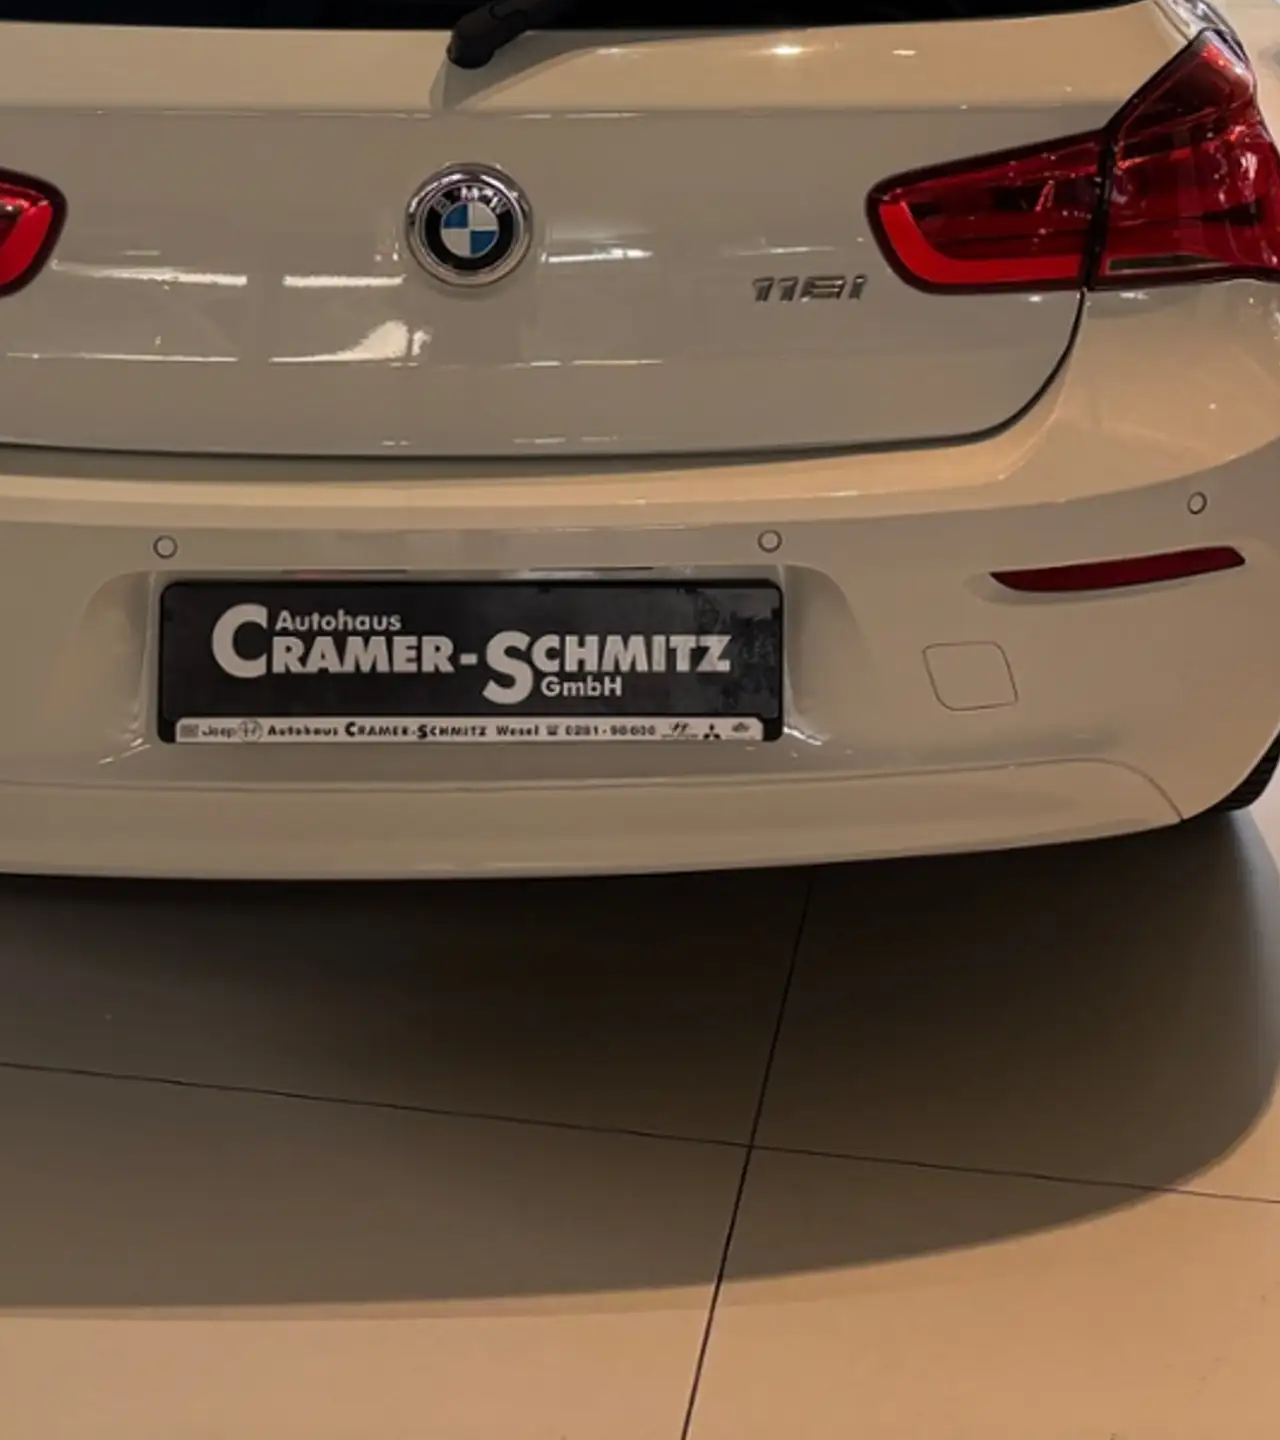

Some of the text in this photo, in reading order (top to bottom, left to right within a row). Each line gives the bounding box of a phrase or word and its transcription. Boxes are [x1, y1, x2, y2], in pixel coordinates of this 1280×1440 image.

[432, 185, 511, 214] BMW
[752, 274, 868, 302] 116i
[274, 609, 402, 631] Autohaus
[540, 675, 623, 697] GmbH
[267, 725, 340, 737] Autohaus
[495, 724, 540, 737] Wesel
